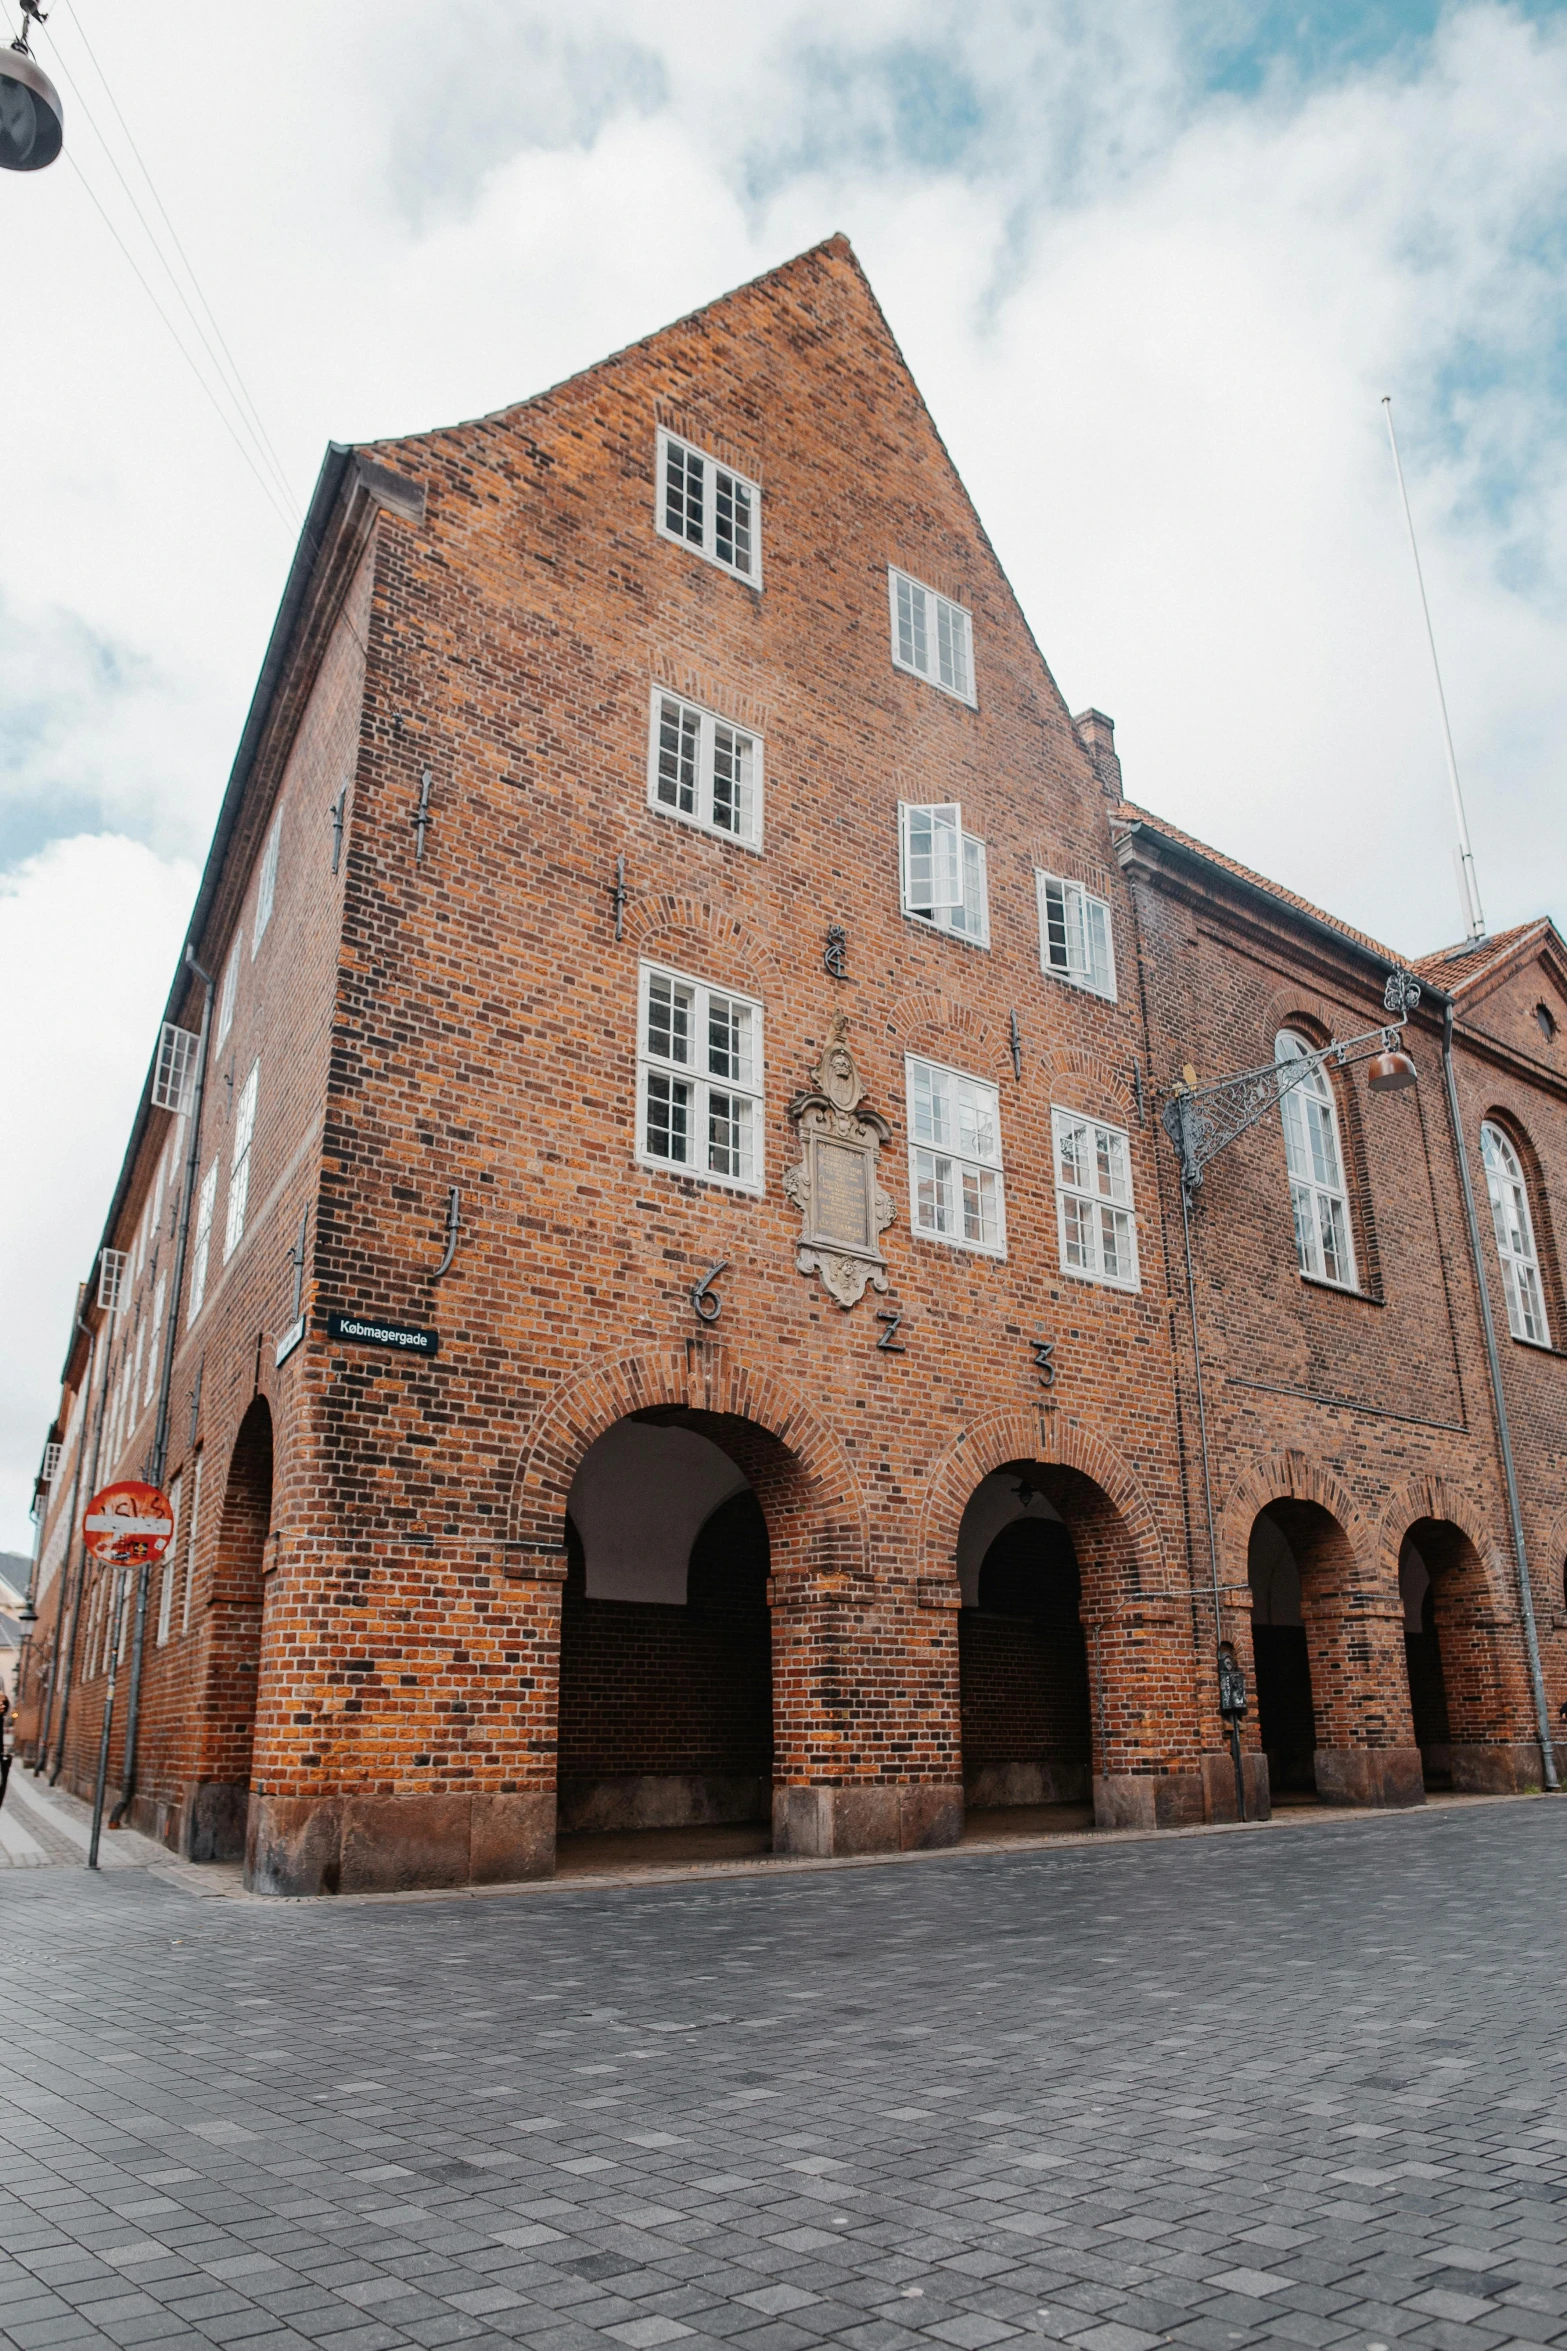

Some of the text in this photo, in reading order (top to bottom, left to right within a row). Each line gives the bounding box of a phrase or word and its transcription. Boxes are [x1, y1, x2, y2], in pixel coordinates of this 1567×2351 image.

[340, 1320, 427, 1346] Købmagergade
[694, 1260, 728, 1321] 6
[1030, 1340, 1055, 1387] 3
